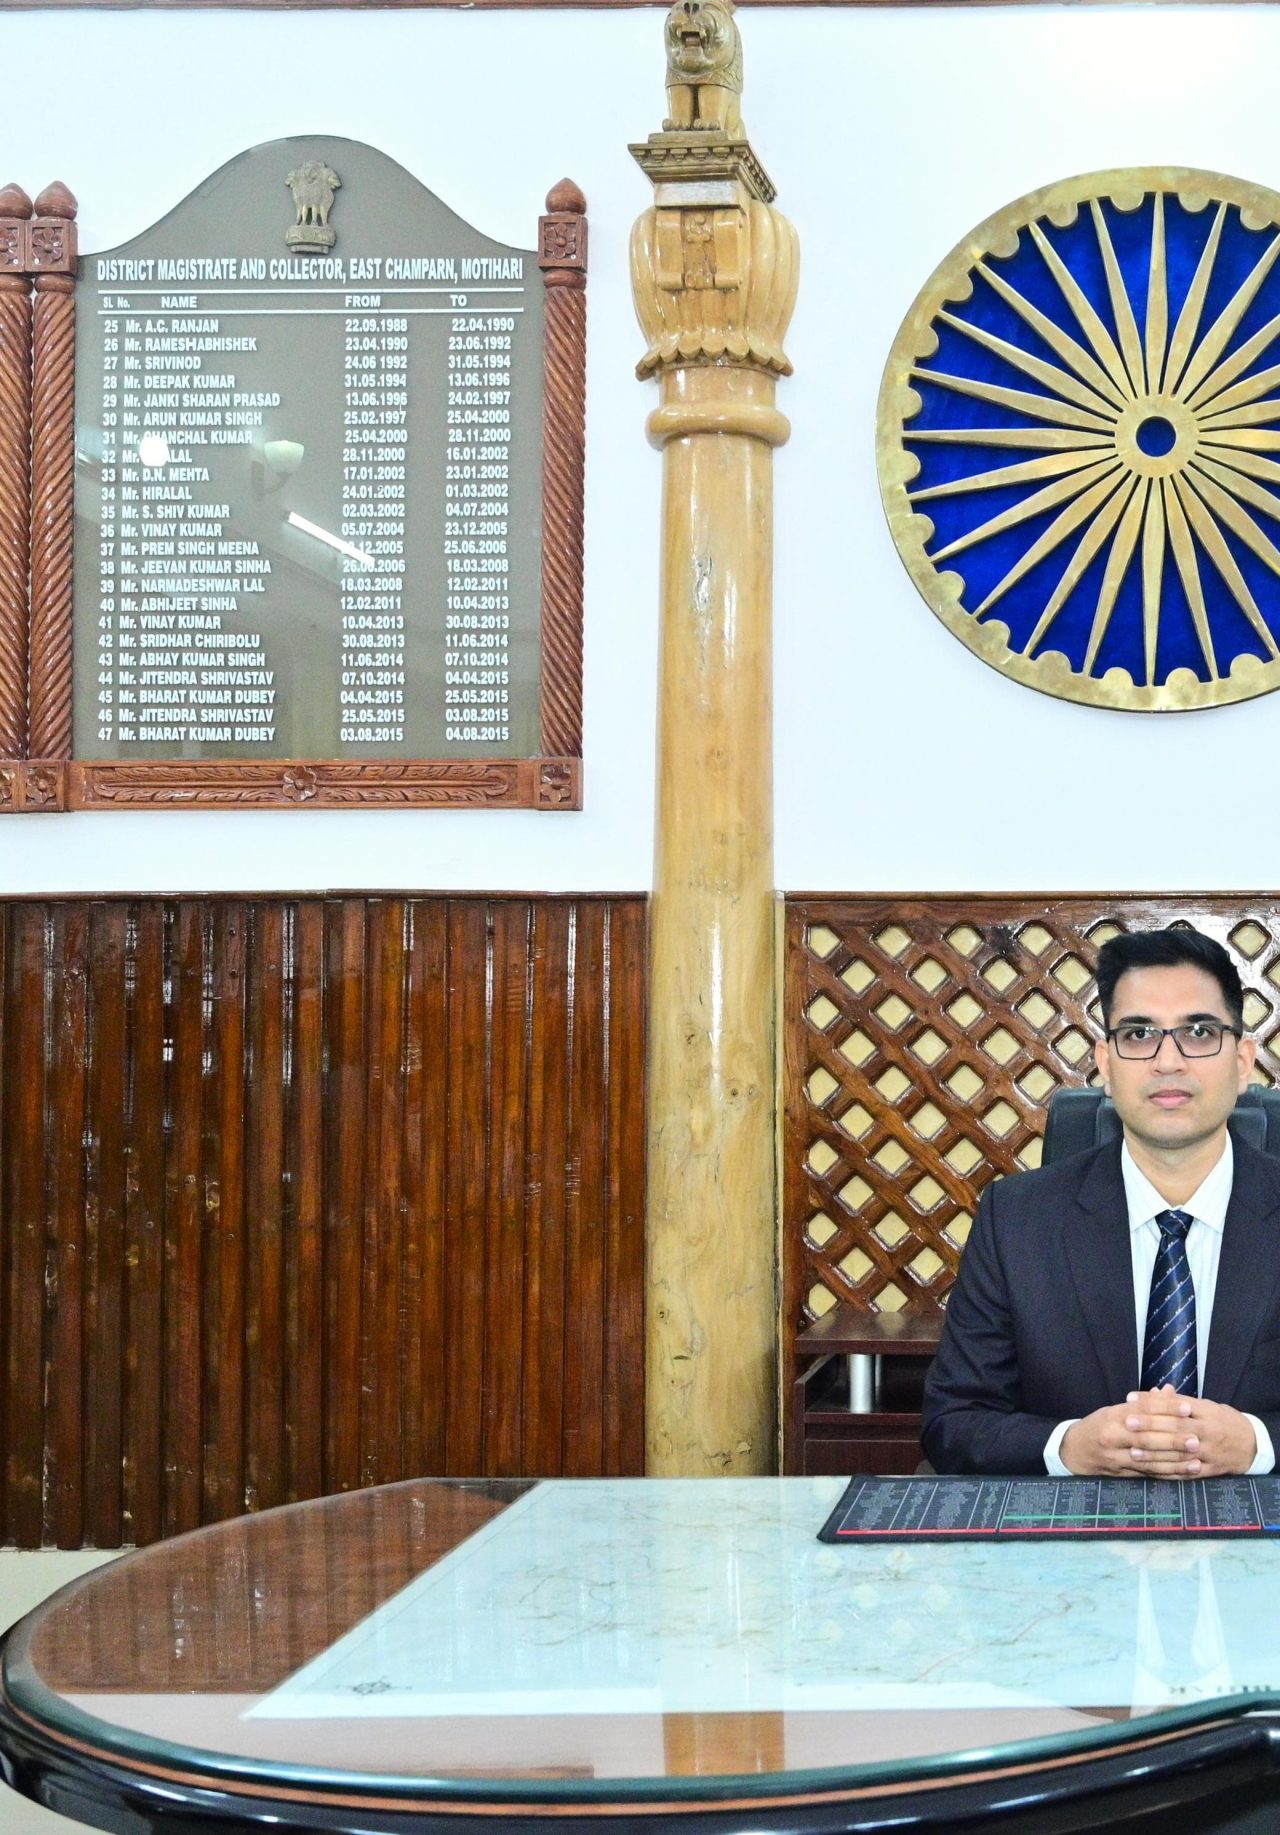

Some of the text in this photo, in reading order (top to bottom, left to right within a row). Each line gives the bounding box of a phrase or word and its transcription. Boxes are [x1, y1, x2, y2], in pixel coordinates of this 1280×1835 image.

[97, 258, 522, 284] DISTRICT MAGISTRATE AND COLLECTOR, EAST CHAMPARN, MOTIHARI
[117, 296, 130, 307] No.
[161, 296, 197, 307] NAME
[344, 295, 380, 306] FROM
[449, 294, 467, 306] TO
[104, 317, 514, 332] 25 Mr. A.C. RANJAN 22.09.1988 22.04.1990
[103, 372, 510, 388] 28 Mr. DEEPAK KUMAR 31.05.1994 13.06.1996
[102, 391, 510, 407] 29 Mr. JANKI SHARAN PRASAD 13.06.1996 24.02.1997
[101, 465, 508, 481] 33 Mr. D.N. MEHTA 17.01.2002 23.01.2002
[100, 502, 508, 518] 35 Mr. S. SHIV KUMAR 02.03.2002 04.07.2004
[100, 522, 507, 537] 36 Mr. VINAY KUMAR 05.07.2004 23.12.2005
[100, 577, 507, 592] 39 Mr. NARMADESHWAR LAL 18.03.2008 12.02.2011
[99, 596, 508, 611] 40 Mr. ABHIJEET SINHA 12.02.2011 10.04.2013
[98, 652, 508, 666] 43 Mr. ABHAY KUMAR SINGH 11.06.2014 07.10.2014
[97, 708, 508, 722] 46 Mr. JITENDRA SHRIVASTAV 25.05.2015 03.08.2015
